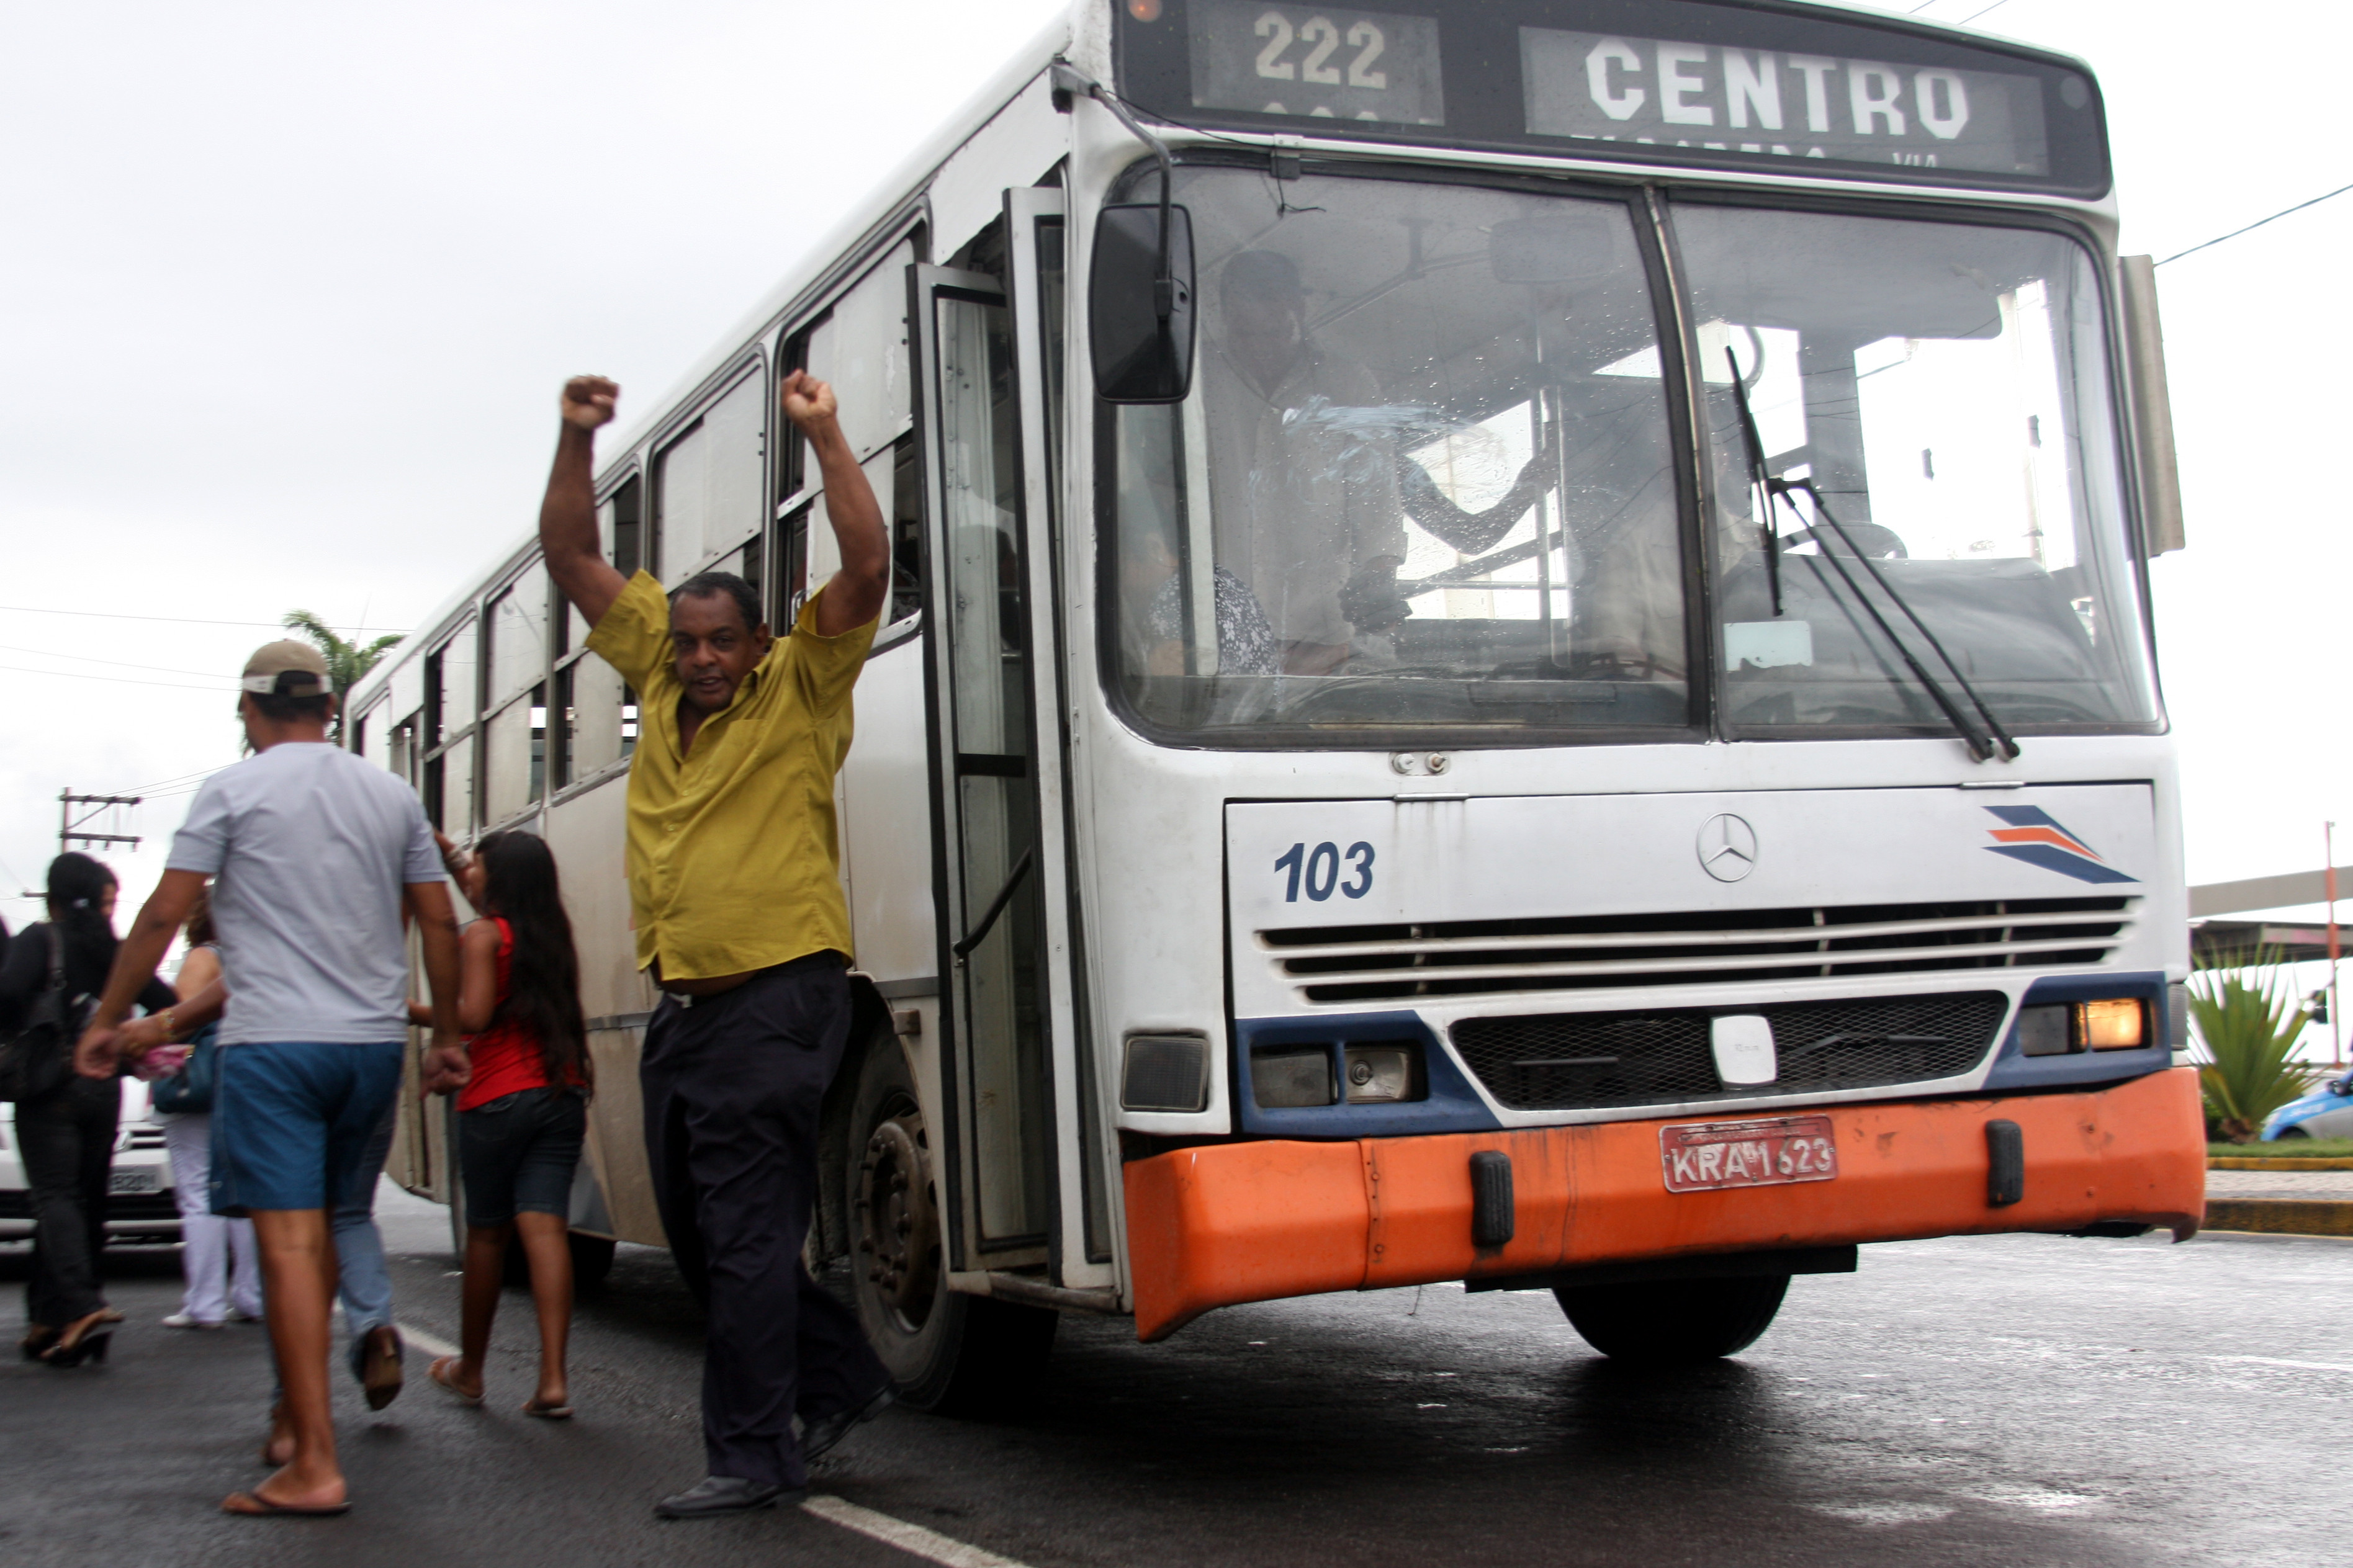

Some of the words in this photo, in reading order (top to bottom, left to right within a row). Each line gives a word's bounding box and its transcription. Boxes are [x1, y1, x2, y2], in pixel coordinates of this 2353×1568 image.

[1254, 11, 1387, 89] 222
[1585, 38, 1969, 140] CENTRO
[1274, 841, 1375, 902] 103
